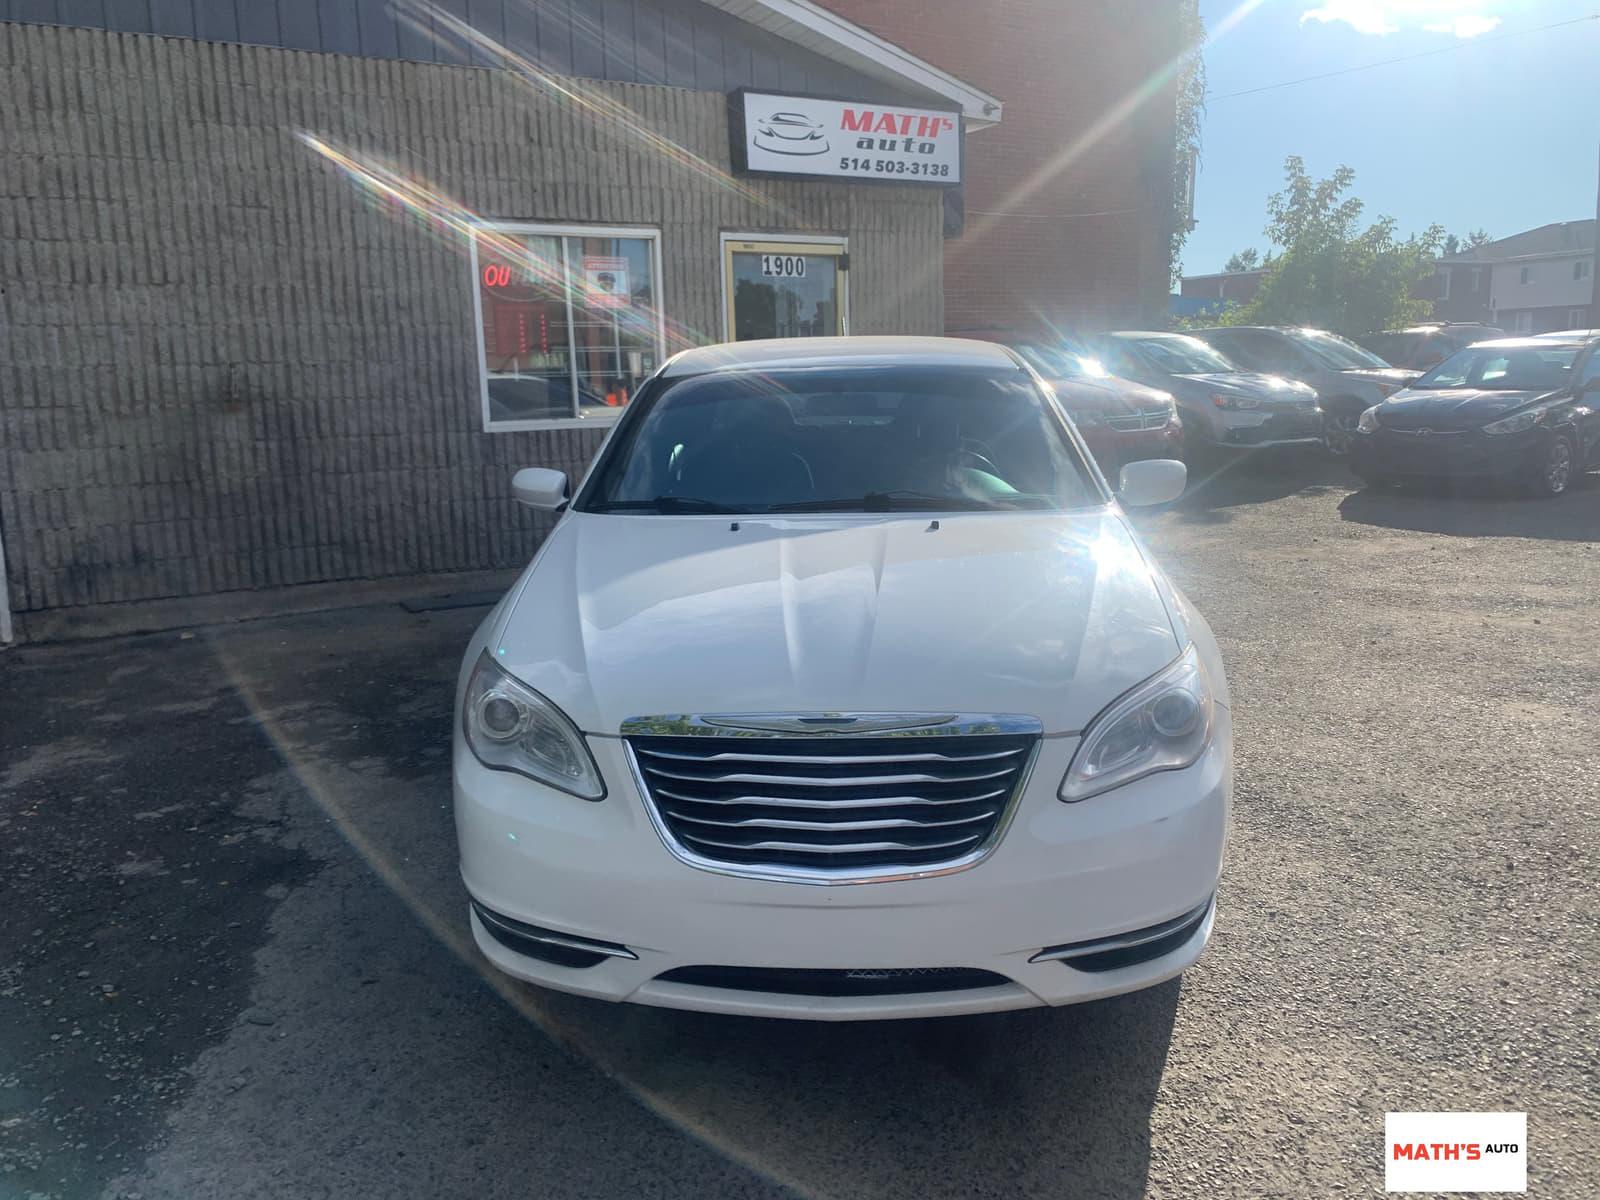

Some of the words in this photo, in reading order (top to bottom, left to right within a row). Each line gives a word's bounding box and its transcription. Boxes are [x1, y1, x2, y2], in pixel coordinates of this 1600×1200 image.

[856, 137, 936, 154] auto
[840, 157, 871, 171] 514
[875, 160, 949, 177] 503-3138
[763, 255, 805, 277] 1900
